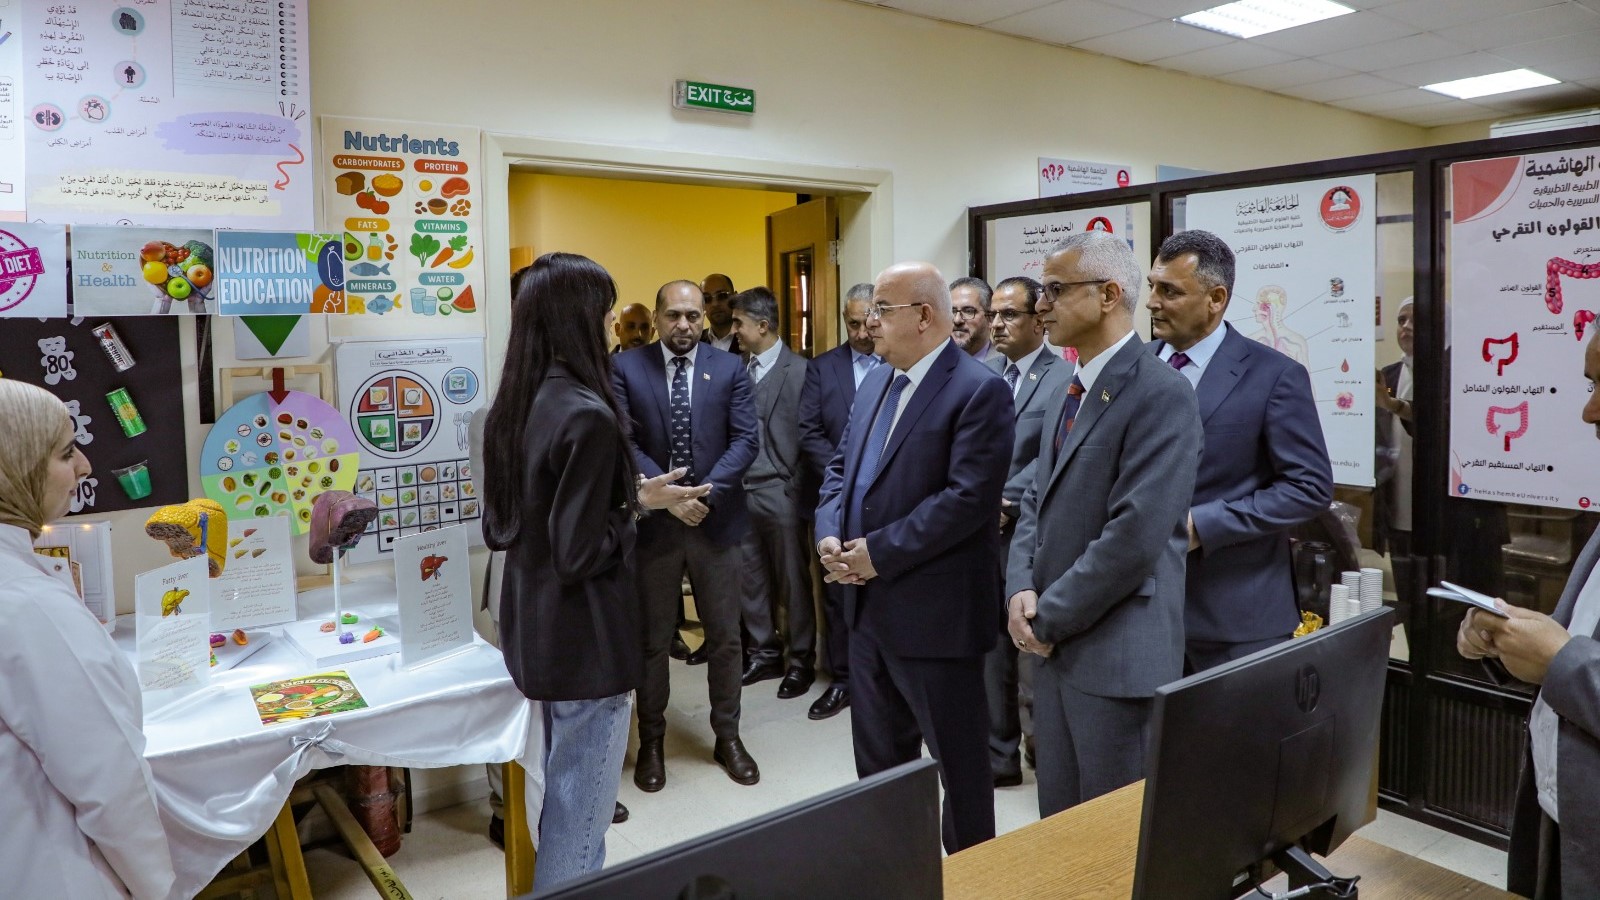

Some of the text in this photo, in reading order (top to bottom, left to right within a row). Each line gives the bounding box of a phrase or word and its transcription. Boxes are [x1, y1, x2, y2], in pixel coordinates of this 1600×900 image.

[688, 85, 722, 104] EXIT
[344, 130, 460, 156] Nutrients
[337, 158, 401, 169] CARBOHYDRATES
[424, 162, 459, 172] PROTEIN
[1526, 155, 1595, 180] الهاشمية
[1533, 182, 1571, 196] التطبيقية
[1528, 198, 1565, 210] والحميات
[422, 222, 460, 231] VITAMINS
[1492, 220, 1541, 242] التقرحي
[77, 250, 137, 262] Nutrition
[220, 246, 308, 274] NUTRITION
[4, 254, 32, 274] DIET
[101, 262, 114, 273] &
[78, 274, 137, 288] Health
[350, 282, 392, 290] MINERALS
[428, 276, 456, 284] WATER
[220, 277, 314, 304] EDUCATION
[1548, 288, 1556, 298] 5
[47, 354, 68, 374] 80
[1462, 384, 1545, 396] التهاب القولون الشامل
